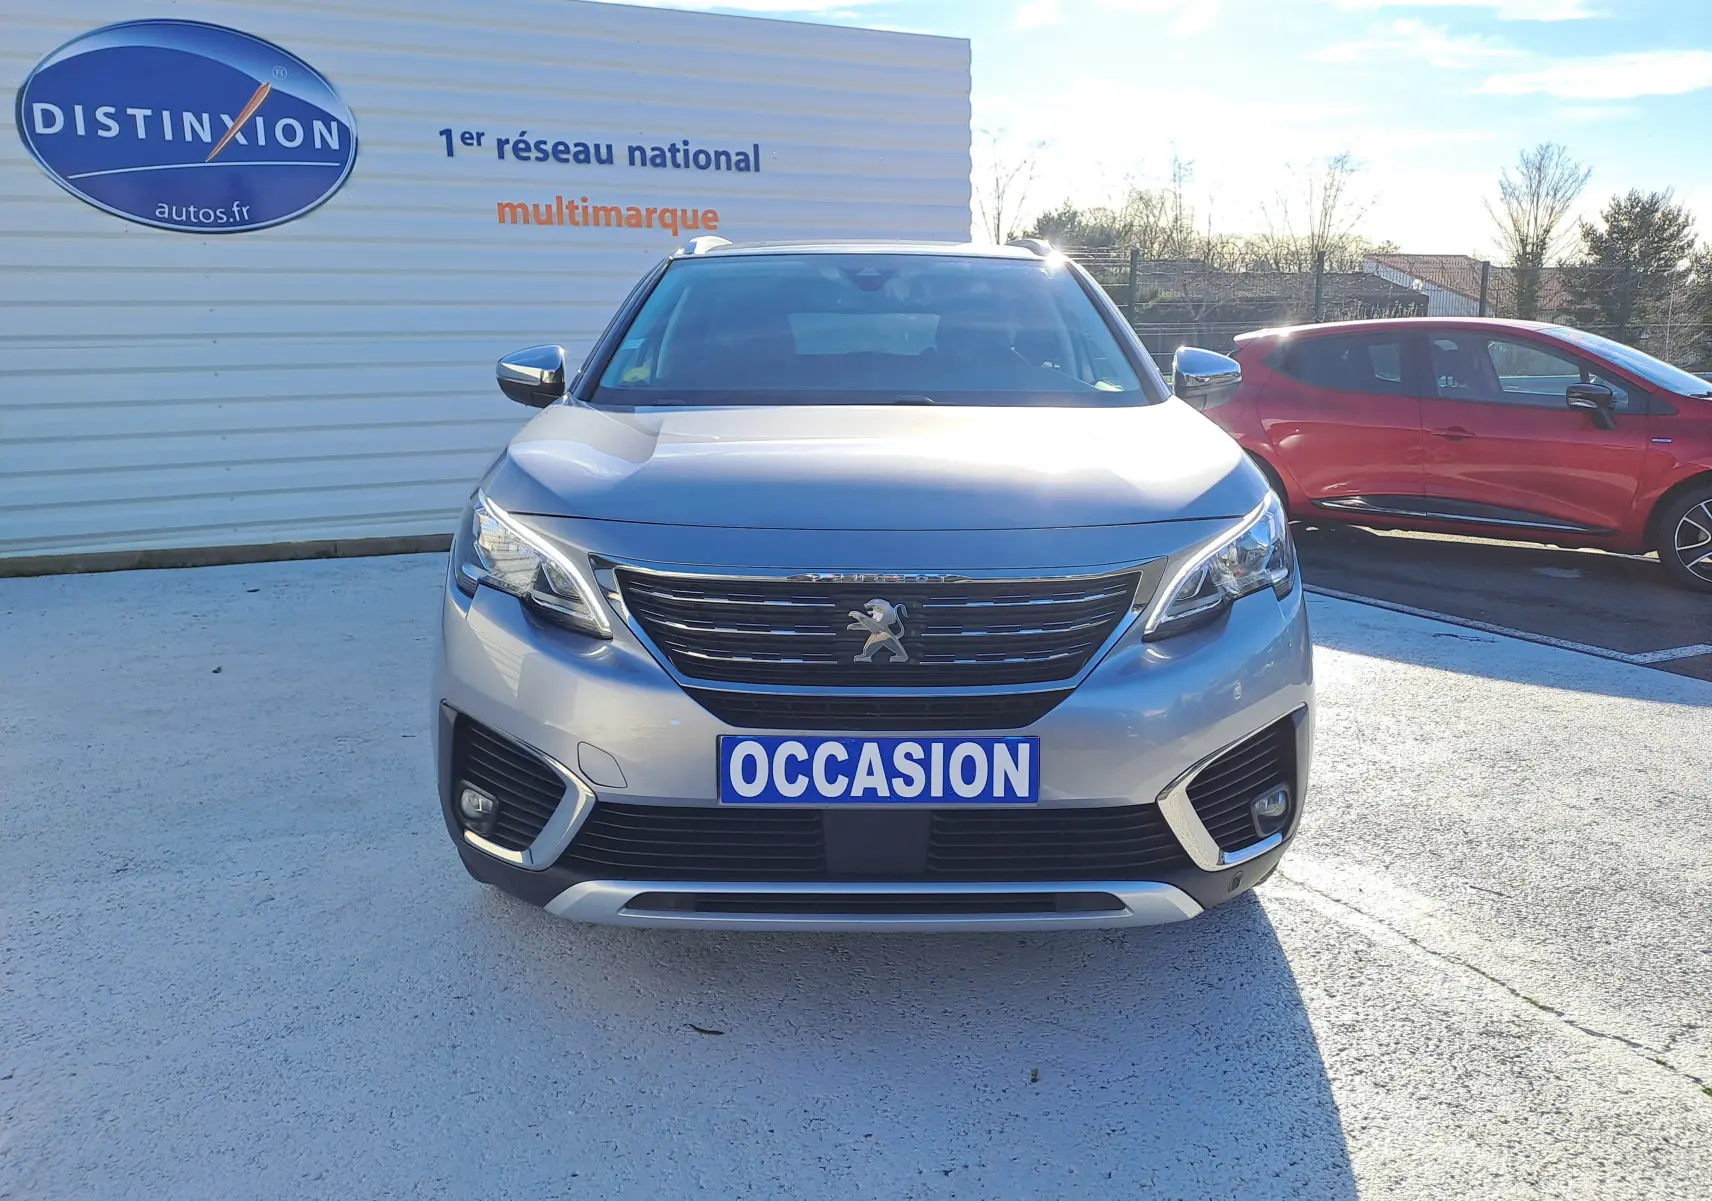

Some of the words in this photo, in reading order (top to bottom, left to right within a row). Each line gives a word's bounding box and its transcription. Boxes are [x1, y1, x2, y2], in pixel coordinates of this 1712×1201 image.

[32, 102, 340, 150] DISTINXION
[438, 128, 485, 157] 1er
[496, 130, 614, 165] réseau
[627, 140, 760, 172] national
[155, 201, 250, 223] autos.fr
[496, 195, 719, 236] multimarque
[729, 741, 1030, 798] OCCASION
